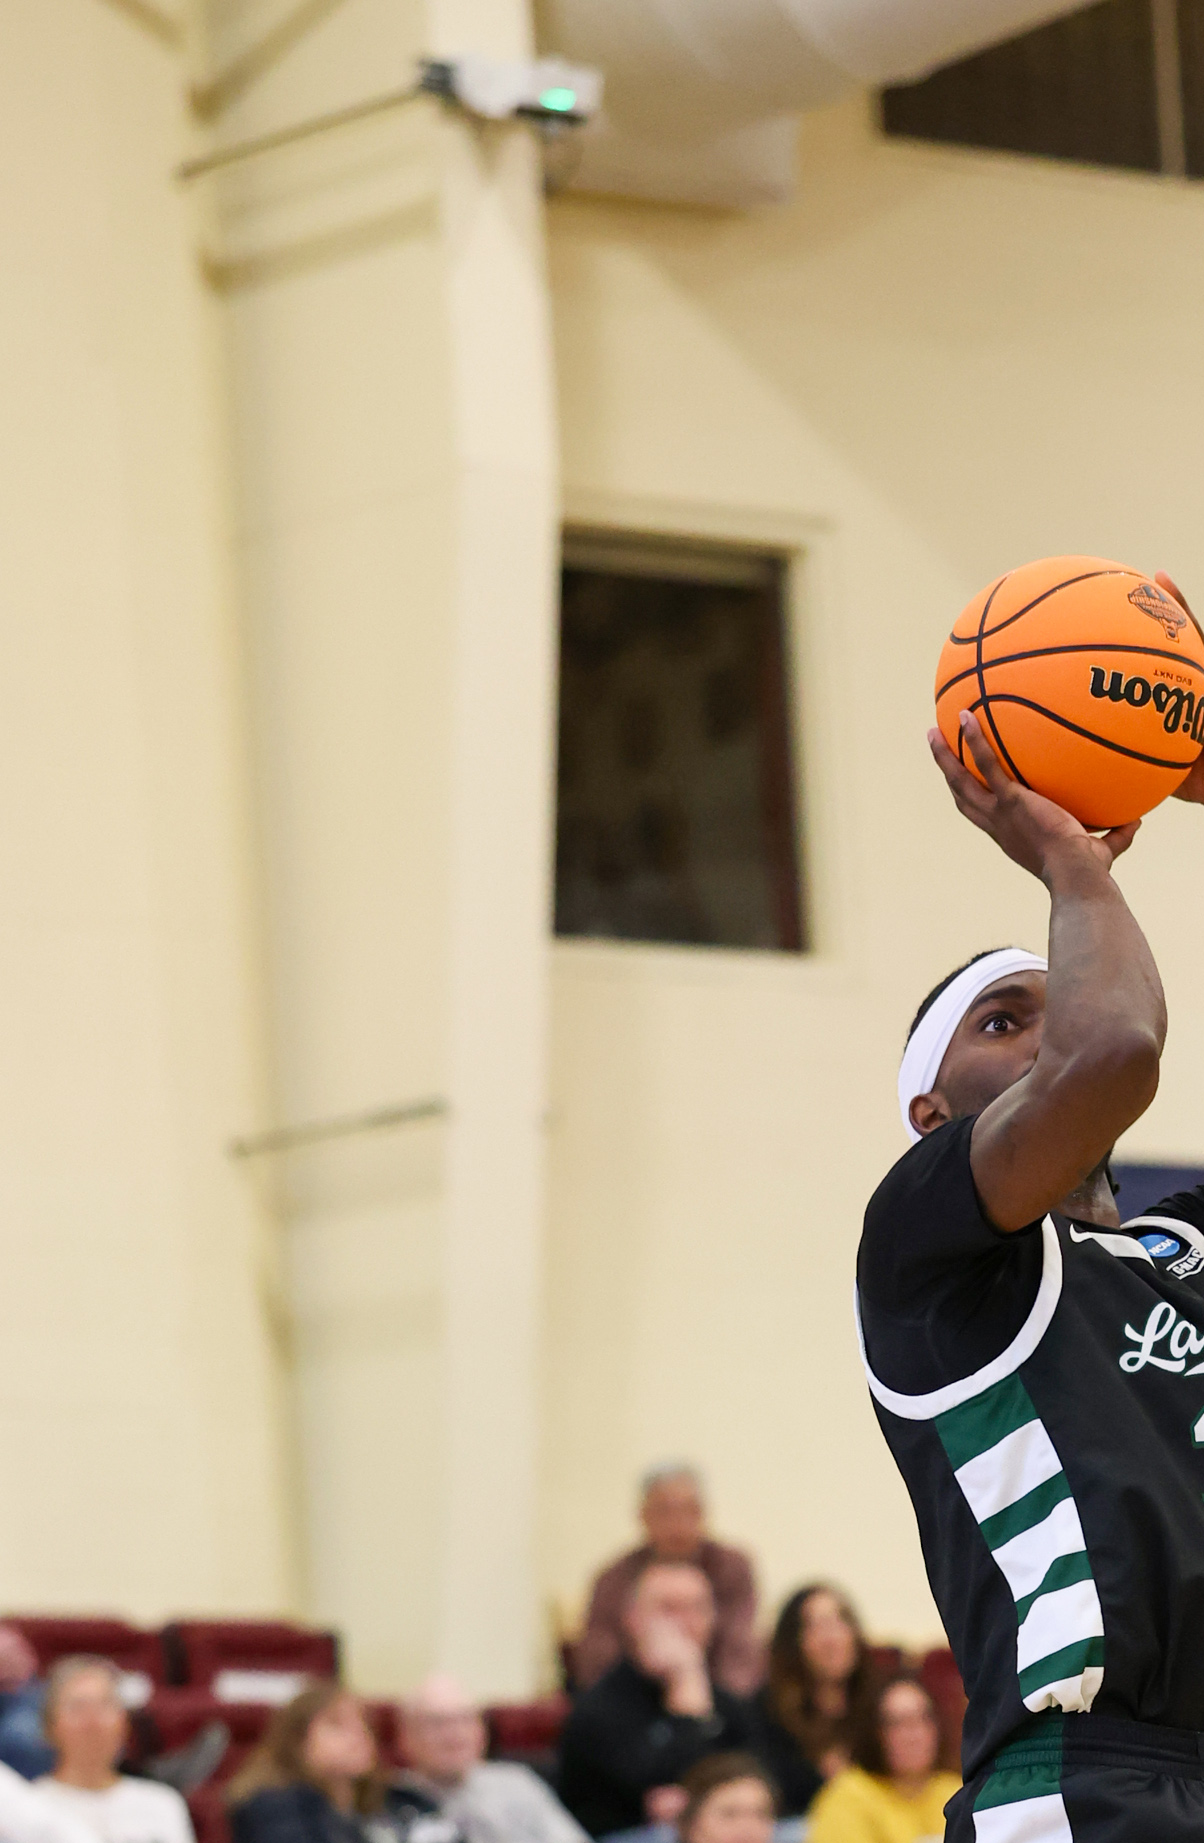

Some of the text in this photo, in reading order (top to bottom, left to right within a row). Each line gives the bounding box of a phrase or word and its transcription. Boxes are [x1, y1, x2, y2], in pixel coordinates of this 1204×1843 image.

[1153, 669, 1193, 686] EVO NXT
[1148, 1238, 1176, 1255] NCAA
